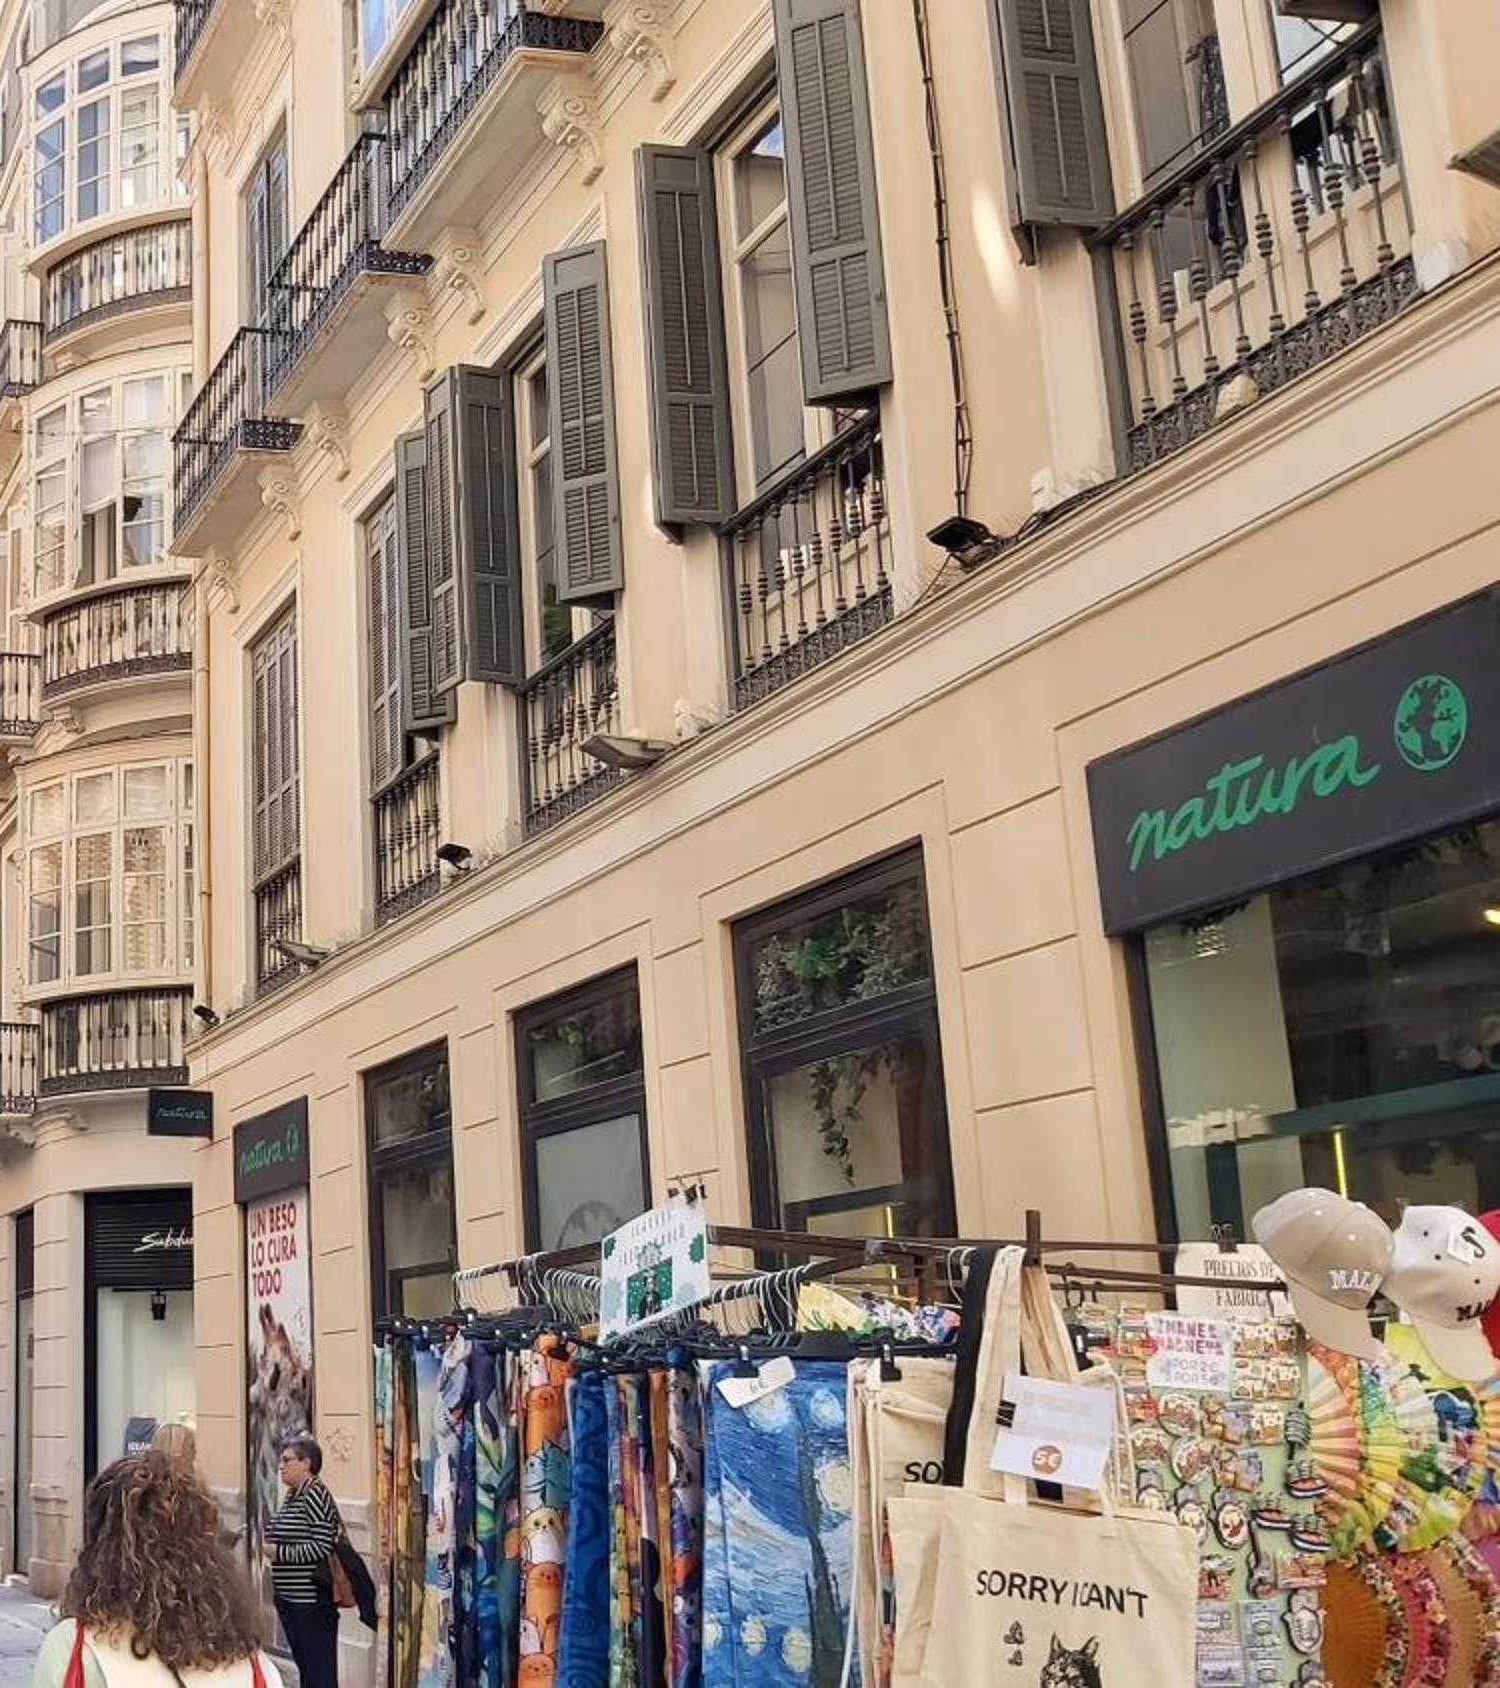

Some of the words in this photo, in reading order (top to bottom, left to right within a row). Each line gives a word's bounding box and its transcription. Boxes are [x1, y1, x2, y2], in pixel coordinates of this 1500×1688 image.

[1126, 736, 1380, 872] natura
[239, 1136, 284, 1178] natura
[251, 1208, 266, 1239] UN
[269, 1202, 297, 1234] BESO
[251, 1241, 265, 1269] LO
[267, 1233, 297, 1265] CURA
[252, 1268, 282, 1298] TODO
[1215, 1289, 1268, 1307] FABRIC
[976, 1569, 1068, 1605] SORRY
